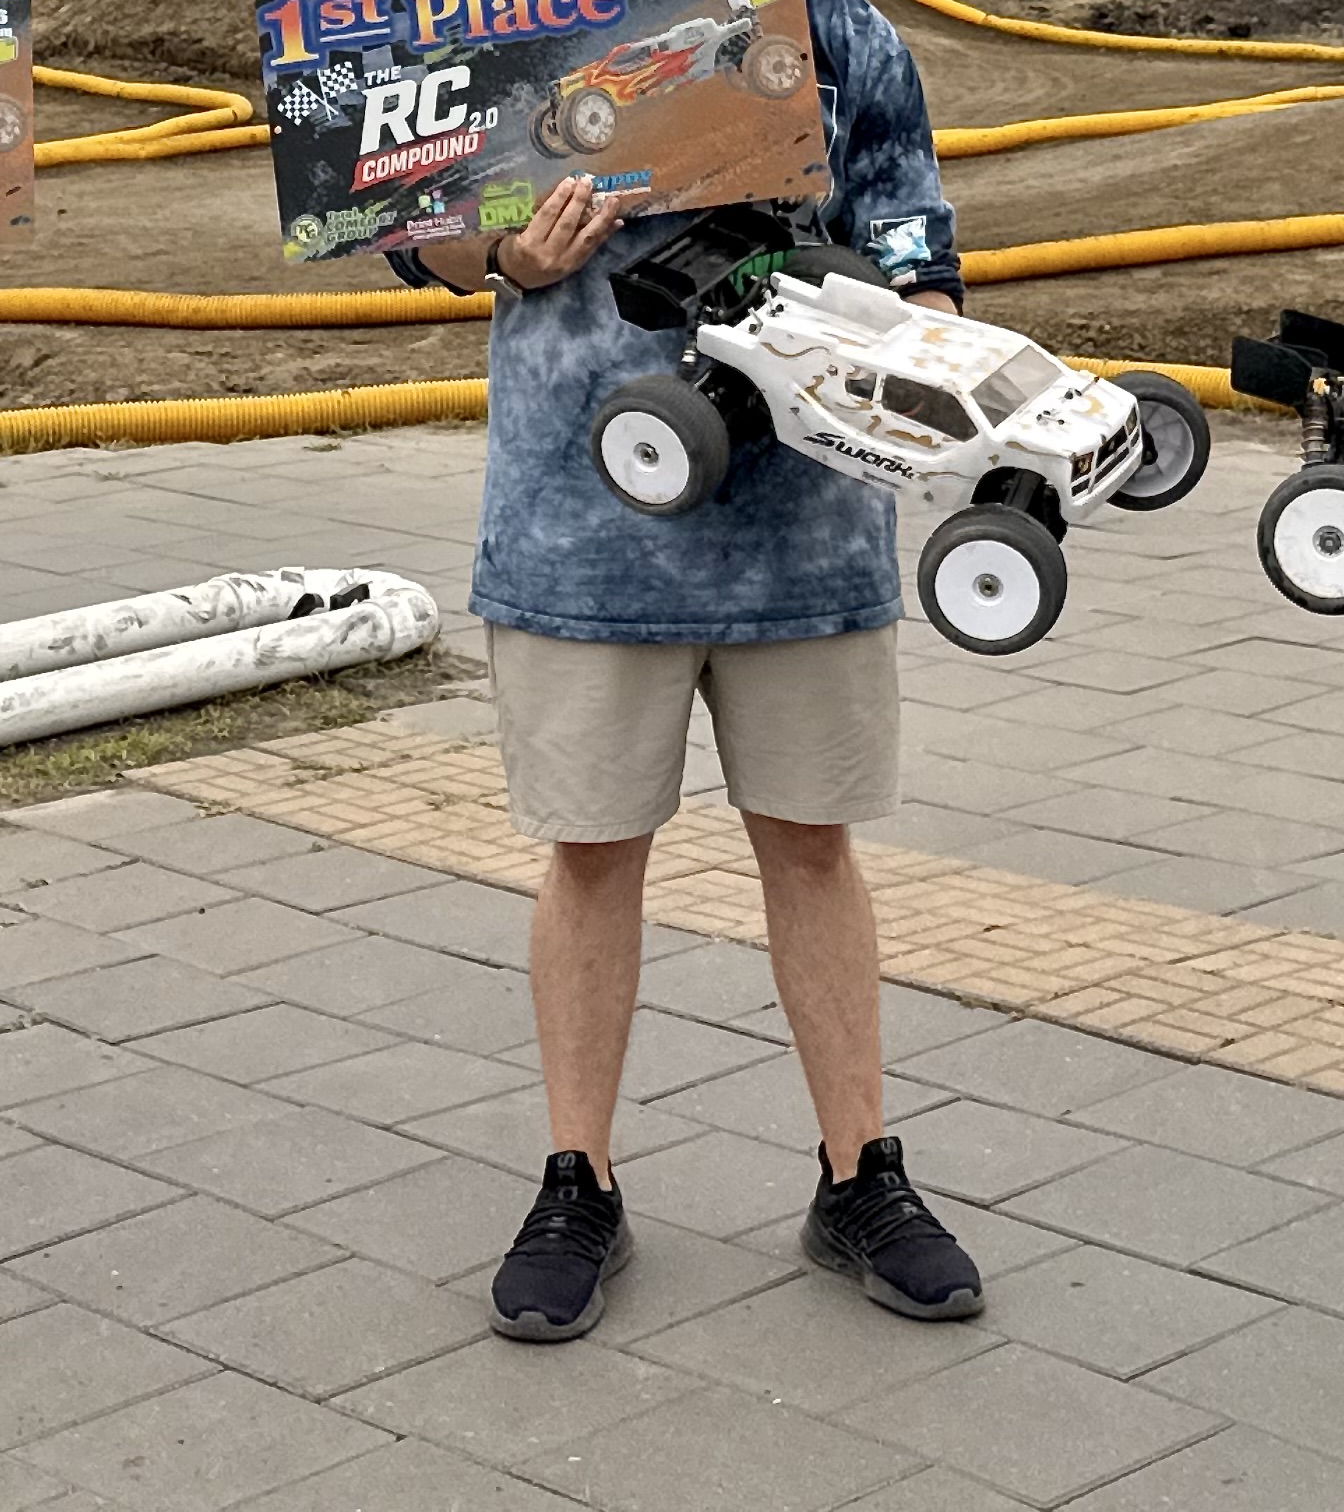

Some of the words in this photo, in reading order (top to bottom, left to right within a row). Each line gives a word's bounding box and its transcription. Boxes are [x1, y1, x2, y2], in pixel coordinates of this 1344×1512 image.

[364, 65, 402, 86] THE
[359, 65, 471, 156] RC
[468, 106, 499, 134] 2.0
[361, 133, 479, 183] COMPOUND
